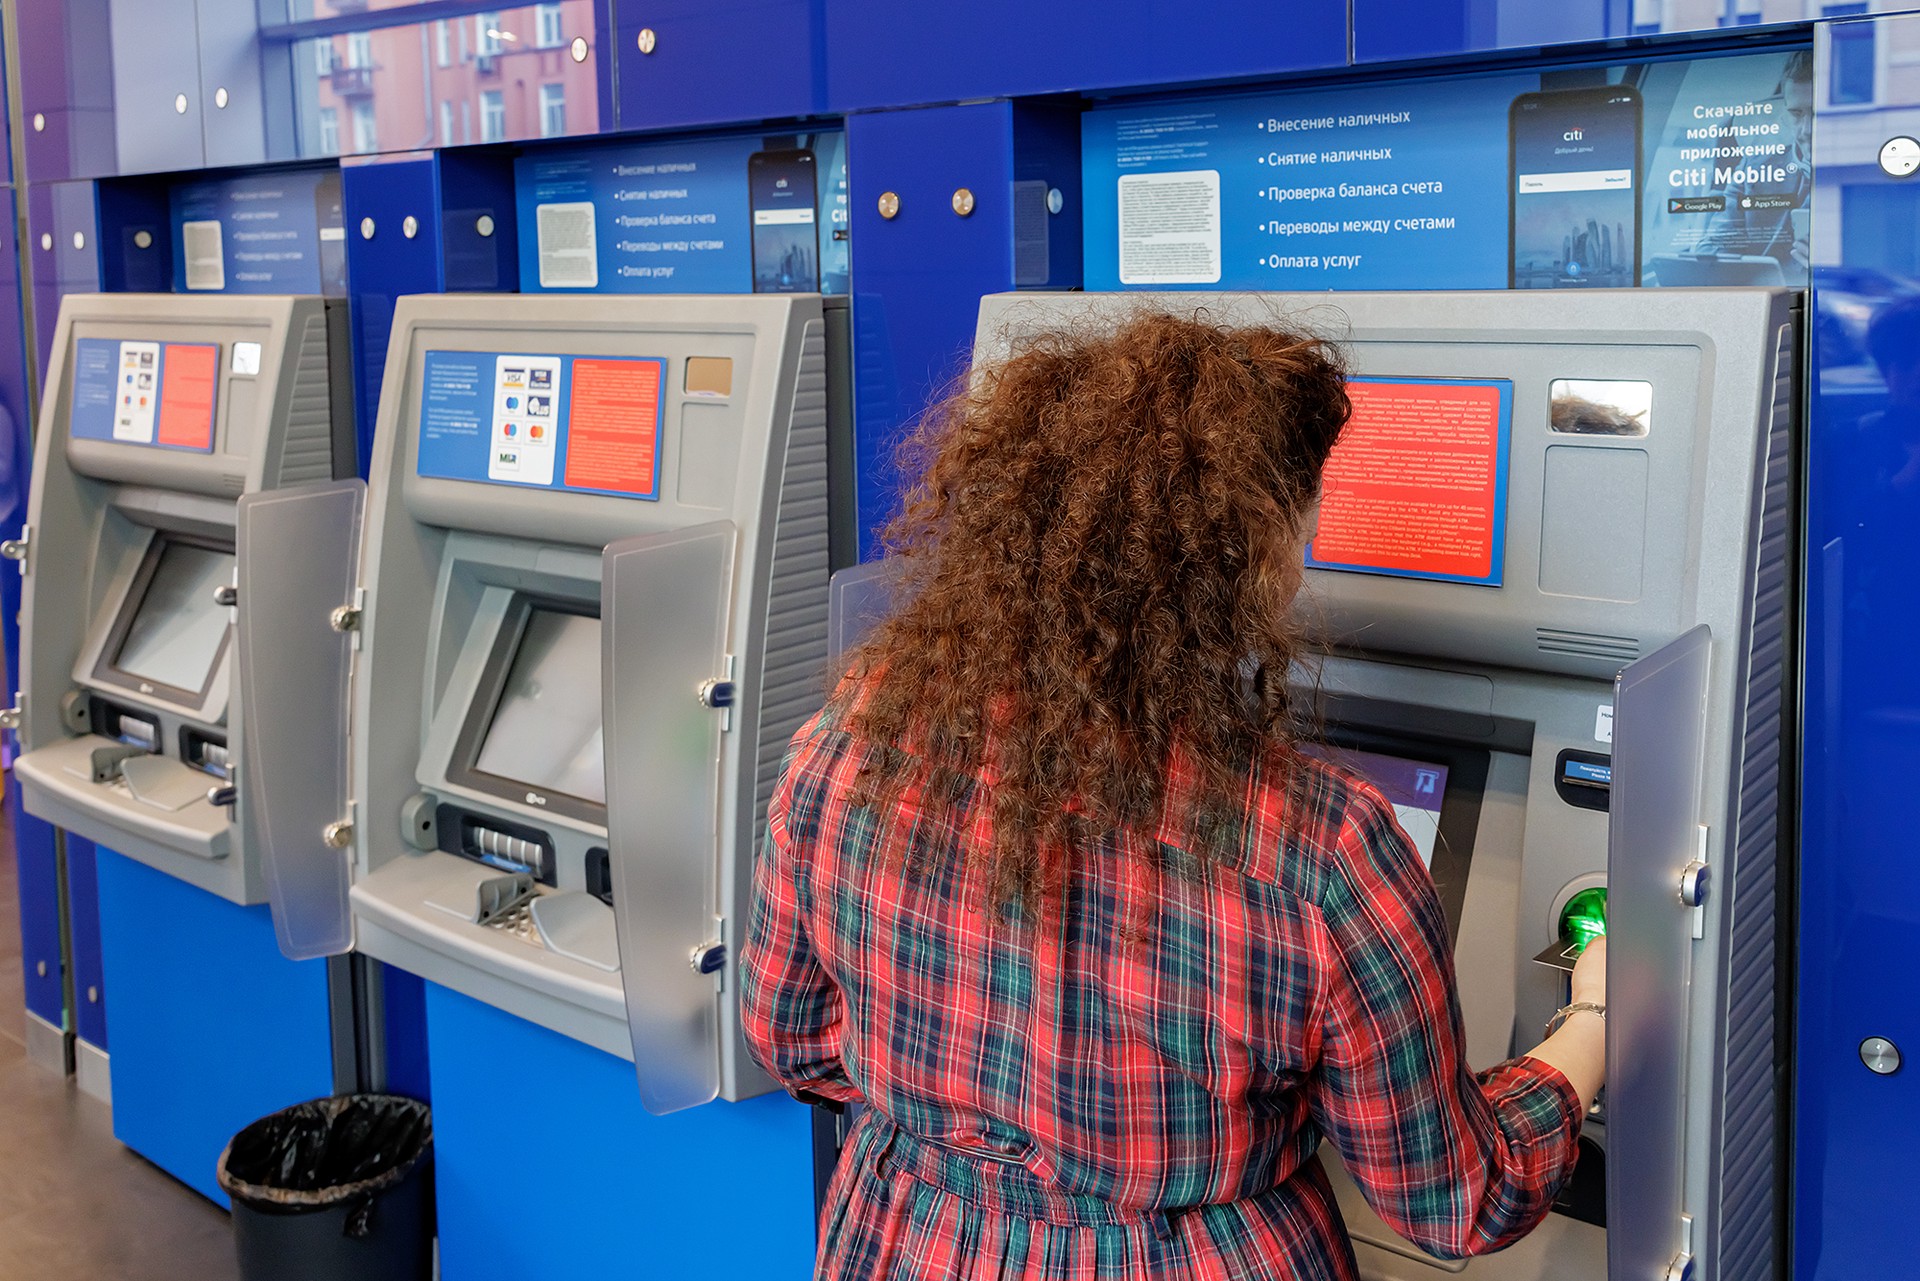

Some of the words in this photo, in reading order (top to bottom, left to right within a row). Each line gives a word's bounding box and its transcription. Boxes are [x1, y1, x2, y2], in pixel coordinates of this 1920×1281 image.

[1694, 103, 1772, 119] Скачайте
[1268, 117, 1334, 132] Внесение
[1339, 112, 1410, 127] наличных
[1563, 128, 1584, 142] citi
[1687, 124, 1779, 139] мобильное
[1268, 153, 1317, 166] Снятие
[1321, 149, 1391, 162] наличных
[1680, 144, 1785, 160] приложение
[619, 166, 655, 176] Внесение
[657, 163, 696, 173] наличных
[1669, 168, 1705, 186] Citi
[620, 190, 647, 201] Снятие
[649, 190, 687, 199] наличных
[1269, 187, 1335, 202] Проверка
[1339, 183, 1397, 197] баланса
[1402, 182, 1442, 194] счета
[621, 216, 658, 227] Проверка
[659, 214, 692, 225] баланса
[693, 214, 716, 223] счета
[1269, 221, 1339, 236] Переводы
[1343, 220, 1390, 233] между
[1395, 218, 1454, 230] счетами
[622, 241, 661, 252] Переводы
[663, 241, 689, 251] между
[690, 241, 723, 250] счетами
[1269, 255, 1318, 268] Оплата
[1323, 256, 1361, 269] услуг
[623, 266, 651, 276] Оплата
[652, 267, 674, 278] услуг
